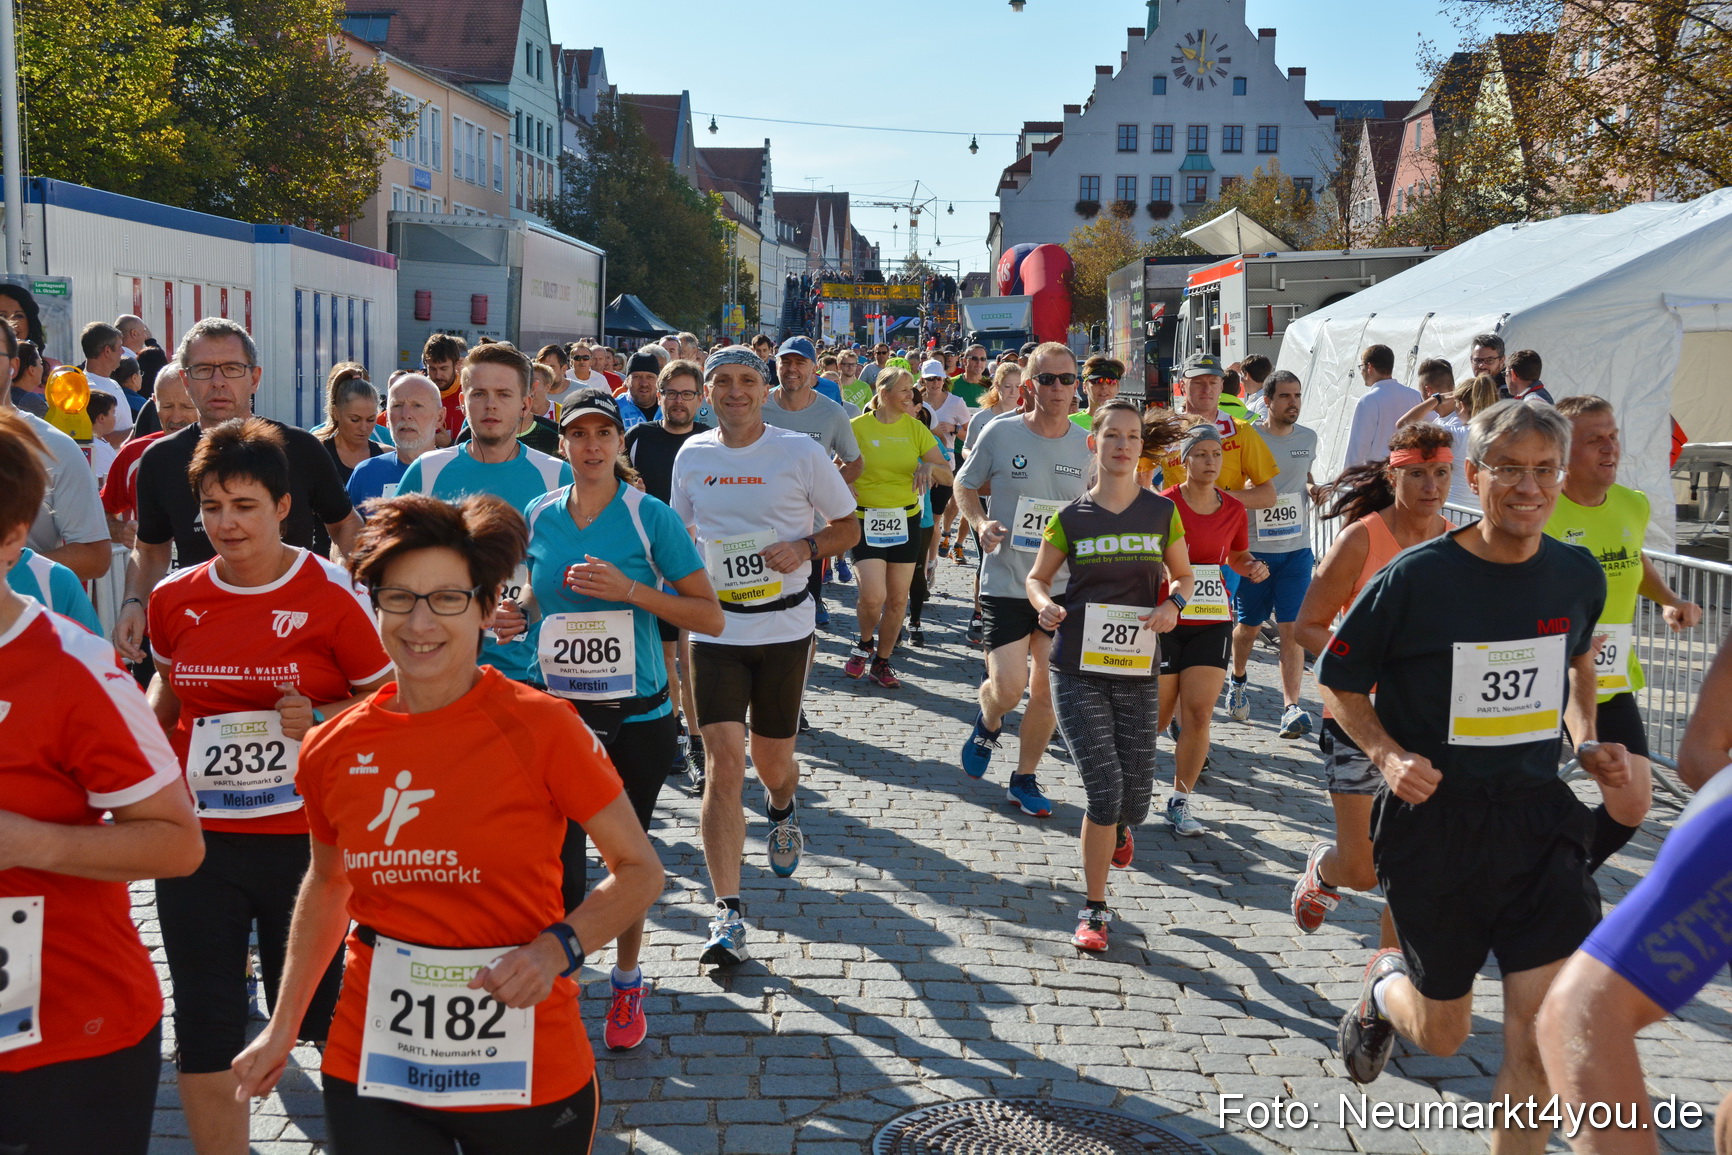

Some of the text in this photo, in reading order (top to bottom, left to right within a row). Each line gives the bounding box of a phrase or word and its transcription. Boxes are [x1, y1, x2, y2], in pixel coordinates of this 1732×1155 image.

[853, 286, 889, 296] START
[1054, 463, 1082, 477] BOCK
[719, 476, 767, 485] KLEBL
[1263, 505, 1297, 523] 2496
[870, 518, 902, 532] 2542
[1267, 527, 1295, 536] Christoph
[723, 540, 756, 552] BOCK
[1073, 532, 1164, 558] BOCK
[722, 553, 764, 579] 189
[731, 588, 766, 601] Guenter
[1194, 580, 1223, 597] 265
[1194, 605, 1223, 614] Christina
[566, 620, 606, 631] BOCK
[1537, 617, 1571, 635] MID
[1101, 622, 1140, 646] 287
[553, 637, 621, 665] 2086
[1488, 648, 1536, 662] BOCK
[1103, 655, 1133, 667] Sandra
[175, 662, 299, 675] ENGELHARDT & WALTER
[258, 673, 300, 681] HERRENHAUS
[569, 679, 608, 691] Kerstin
[1481, 667, 1539, 702] 337
[1476, 703, 1533, 714] PARTL Neumarkt
[221, 721, 268, 736] BOCK
[204, 740, 287, 777] 2332
[349, 765, 379, 775] erima
[213, 778, 271, 787] PARTL Neumarkt
[223, 791, 275, 807] Melanie
[344, 849, 458, 872] funrunners
[372, 865, 482, 886] neumarkt
[411, 961, 484, 982] BOCK
[390, 988, 507, 1042] 2182
[397, 1041, 481, 1058] PARTL Neumarkt
[407, 1065, 481, 1093] Brigitte
